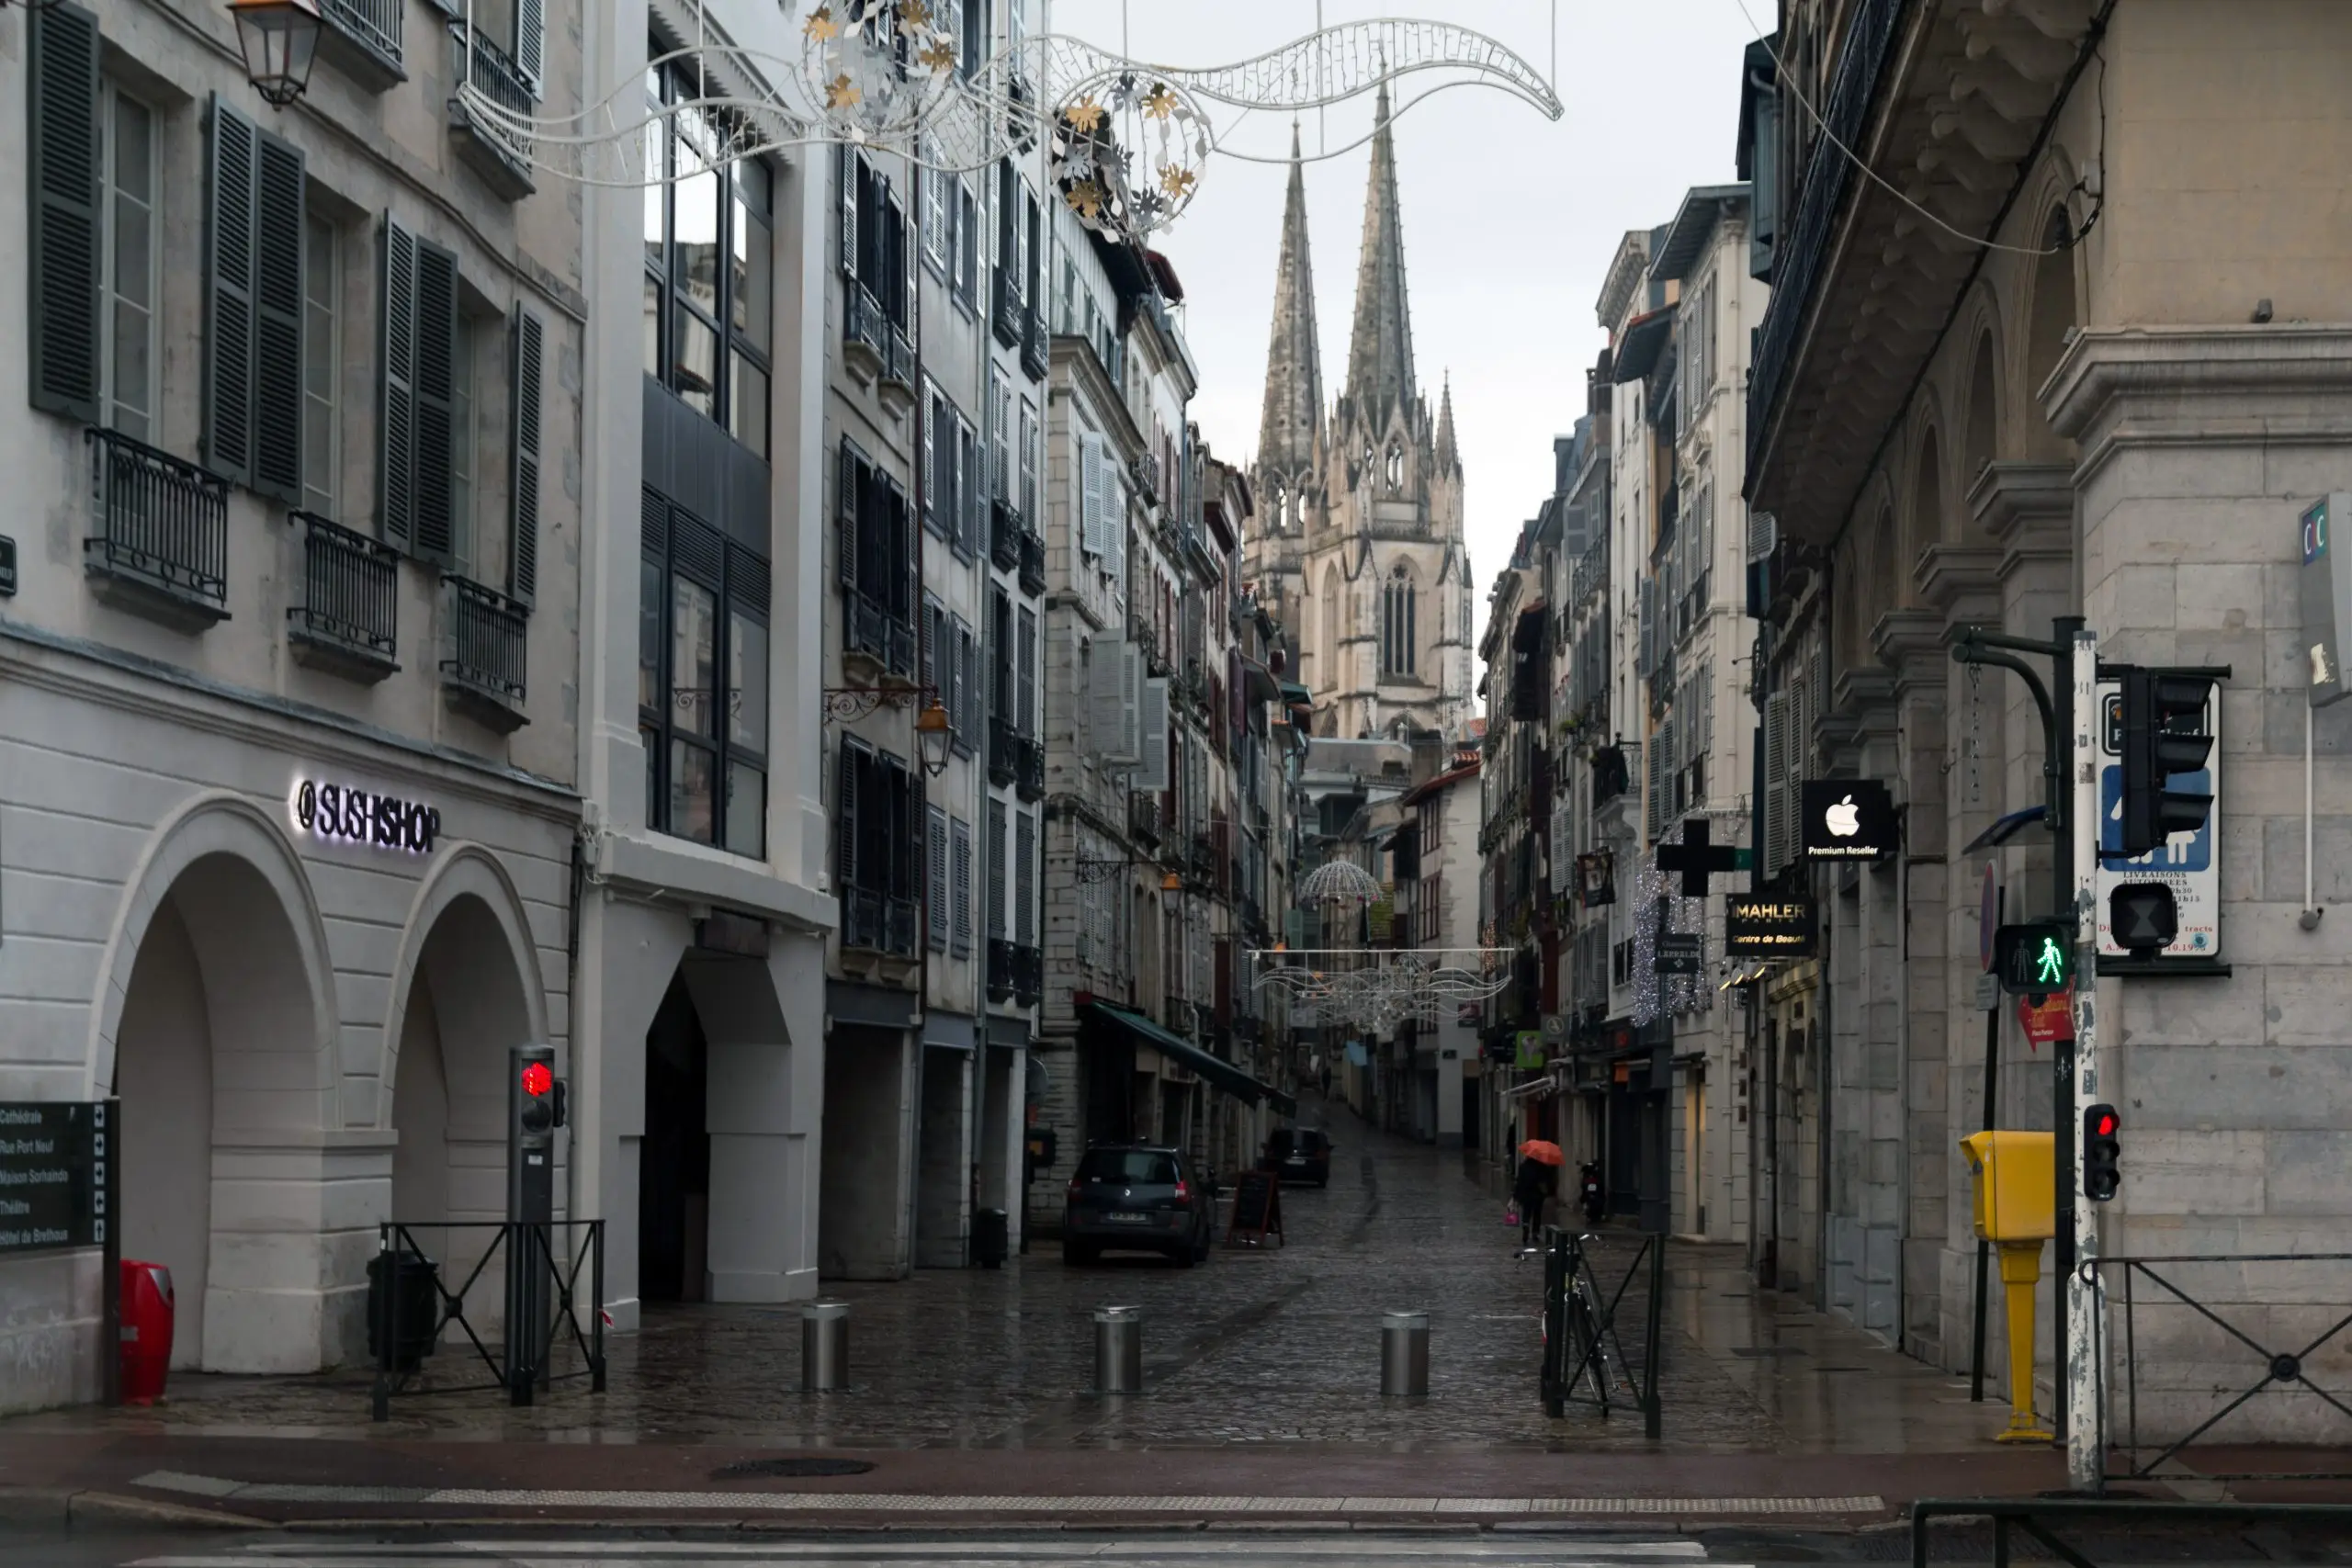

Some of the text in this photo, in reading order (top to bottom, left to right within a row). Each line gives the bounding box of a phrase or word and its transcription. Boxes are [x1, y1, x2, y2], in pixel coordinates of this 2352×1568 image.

[2304, 514, 2324, 555] CIC
[1808, 845, 1879, 855] Premium Reseller
[1735, 904, 1805, 919] MAHLER
[1775, 934, 1805, 942] Beauté
[0, 1110, 42, 1124] Cathédrale
[0, 1139, 53, 1154] Rue Port Neuf
[21, 1229, 31, 1243] de
